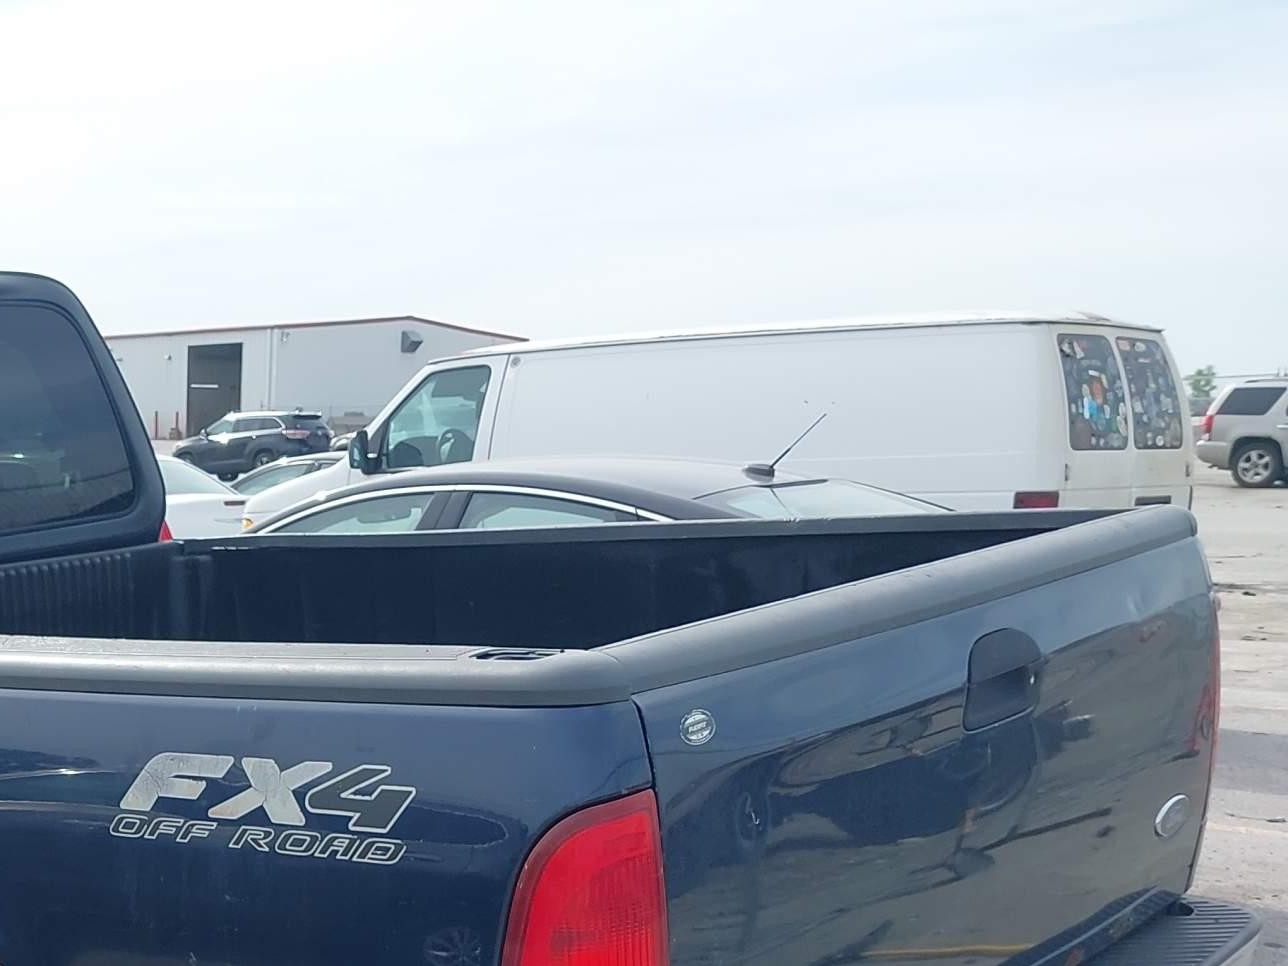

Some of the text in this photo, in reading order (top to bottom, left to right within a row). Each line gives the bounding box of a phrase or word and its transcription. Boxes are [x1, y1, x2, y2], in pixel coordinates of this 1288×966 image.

[119, 752, 416, 833] FX4
[109, 813, 407, 865] OFF ROAD
